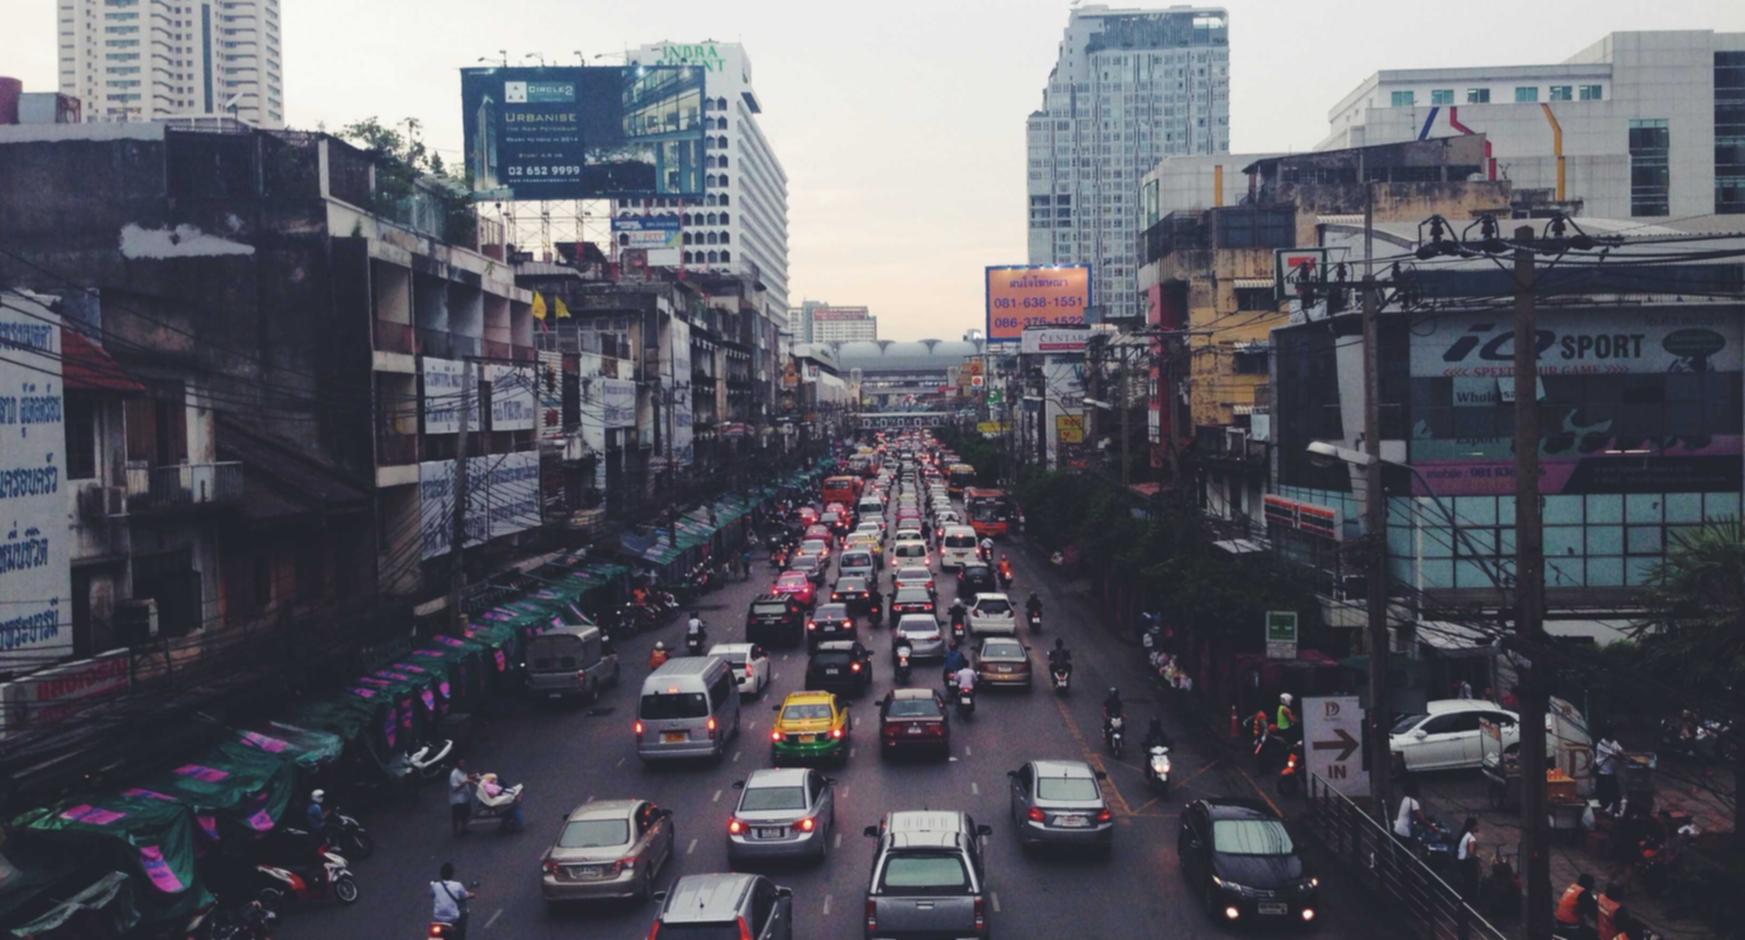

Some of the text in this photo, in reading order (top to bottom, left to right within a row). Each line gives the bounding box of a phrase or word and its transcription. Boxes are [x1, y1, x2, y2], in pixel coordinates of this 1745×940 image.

[663, 45, 718, 59] INDRA
[505, 112, 577, 122] URBANISE
[508, 166, 580, 175] 02 652 9999
[1561, 334, 1645, 359] SPORT
[1328, 765, 1347, 779] IN
